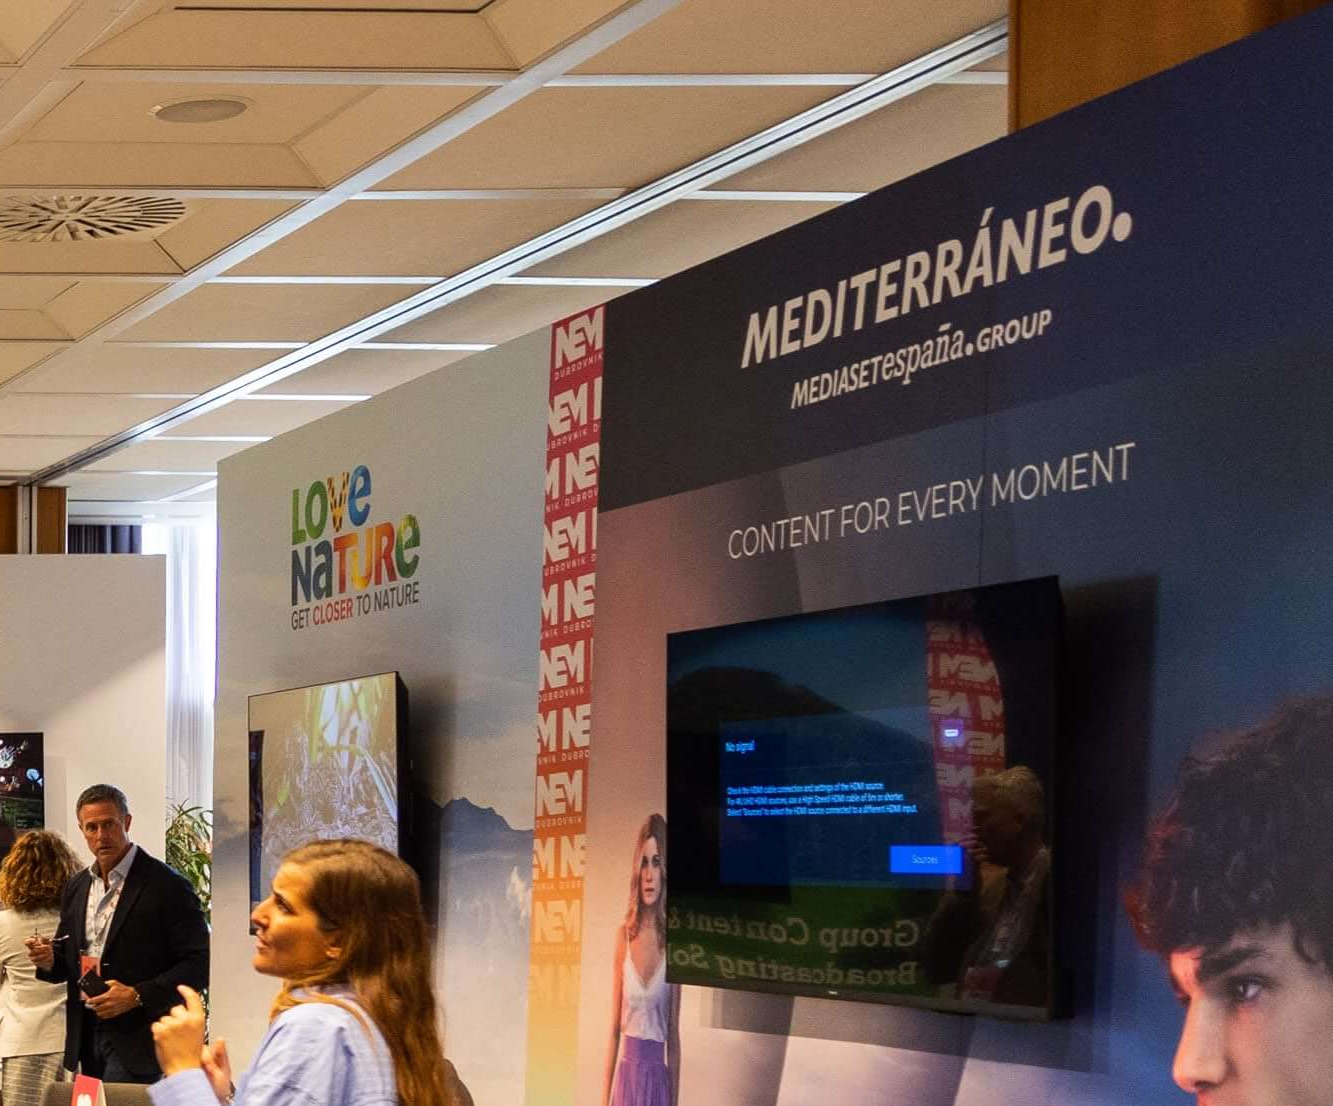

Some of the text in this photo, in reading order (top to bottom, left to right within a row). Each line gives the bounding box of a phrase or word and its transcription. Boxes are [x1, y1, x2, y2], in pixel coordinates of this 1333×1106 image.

[555, 305, 604, 369] NEM
[565, 442, 600, 496] NE
[728, 443, 1135, 559] CONTENT FOR EVERY MOMENT
[291, 582, 419, 630] GET CLOSER TO NATURE
[564, 572, 596, 622] NE
[562, 703, 591, 750] NE
[536, 769, 583, 817] NEM
